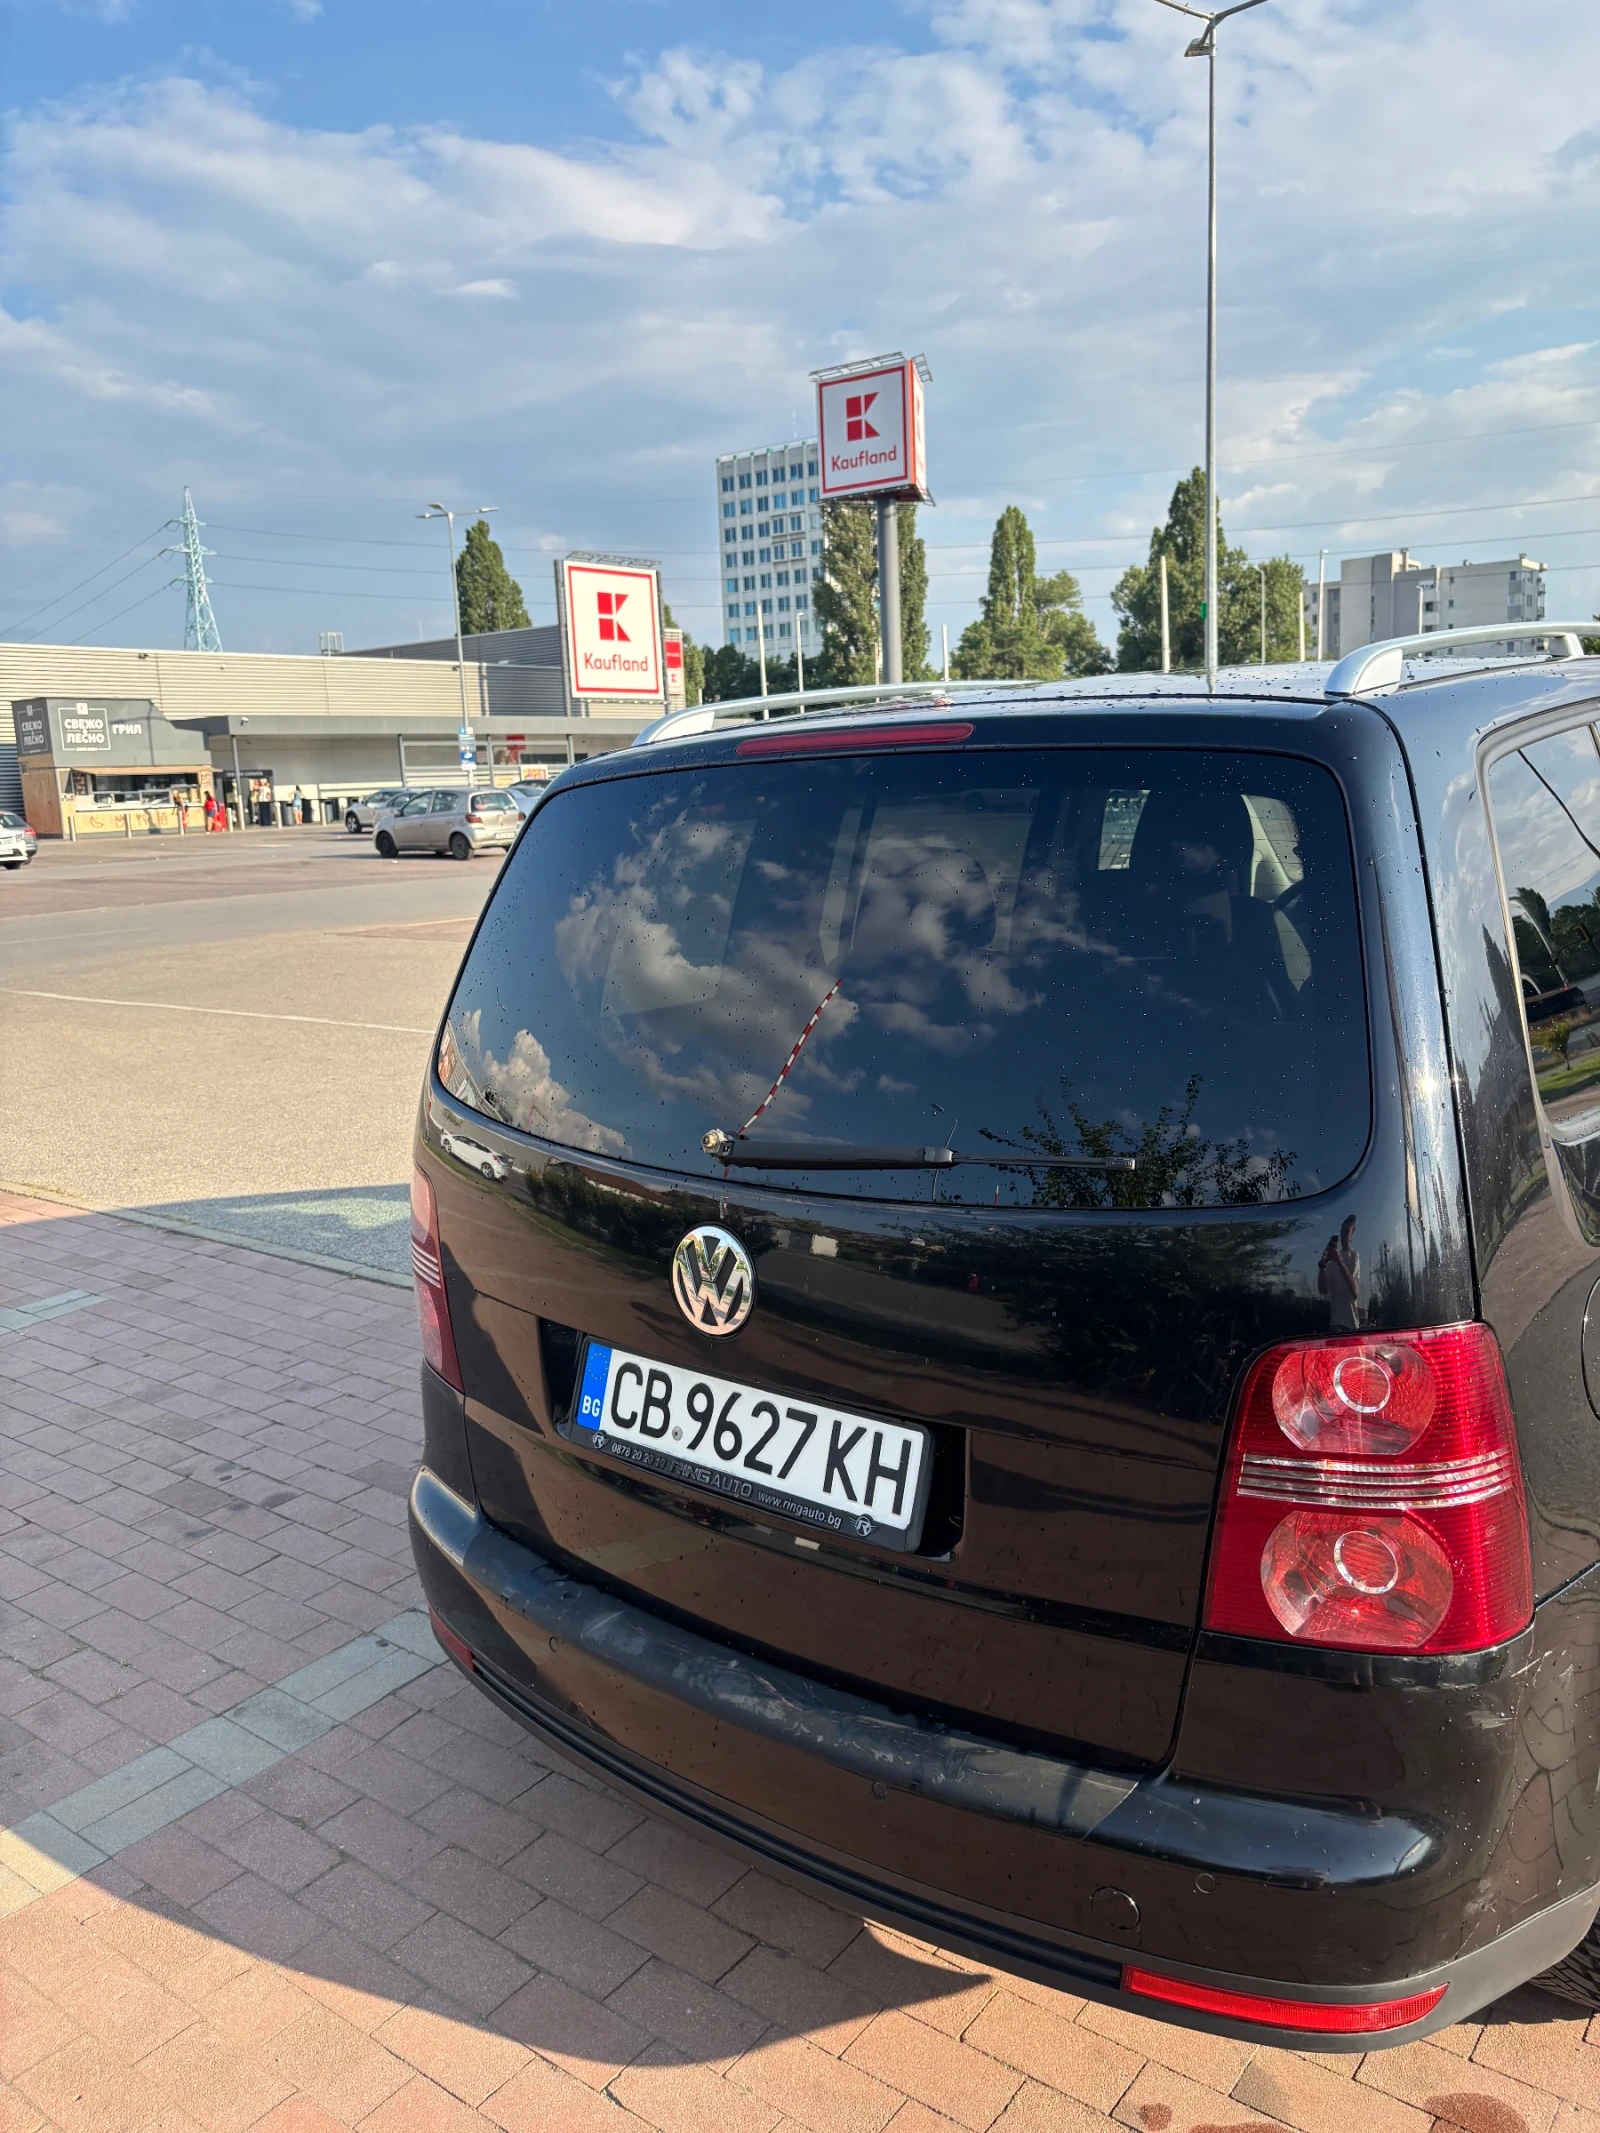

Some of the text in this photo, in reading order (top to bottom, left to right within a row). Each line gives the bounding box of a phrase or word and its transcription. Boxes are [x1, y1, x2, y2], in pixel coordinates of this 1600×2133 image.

[831, 444, 897, 472] Kaufland
[584, 653, 648, 672] Kaufland
[22, 720, 42, 731] СВЕЖО
[64, 719, 103, 729] СВЕЖО
[112, 724, 141, 734] ГРИЛ
[24, 734, 44, 745] ЛЕСНО
[67, 733, 105, 743] ЛЕСНО
[581, 1394, 601, 1418] BG
[611, 1442, 631, 1457] 0878
[631, 1449, 642, 1461] 20
[643, 1453, 654, 1464] 20
[655, 1458, 666, 1468] 10
[758, 1491, 842, 1530] www.ringauto.bg
